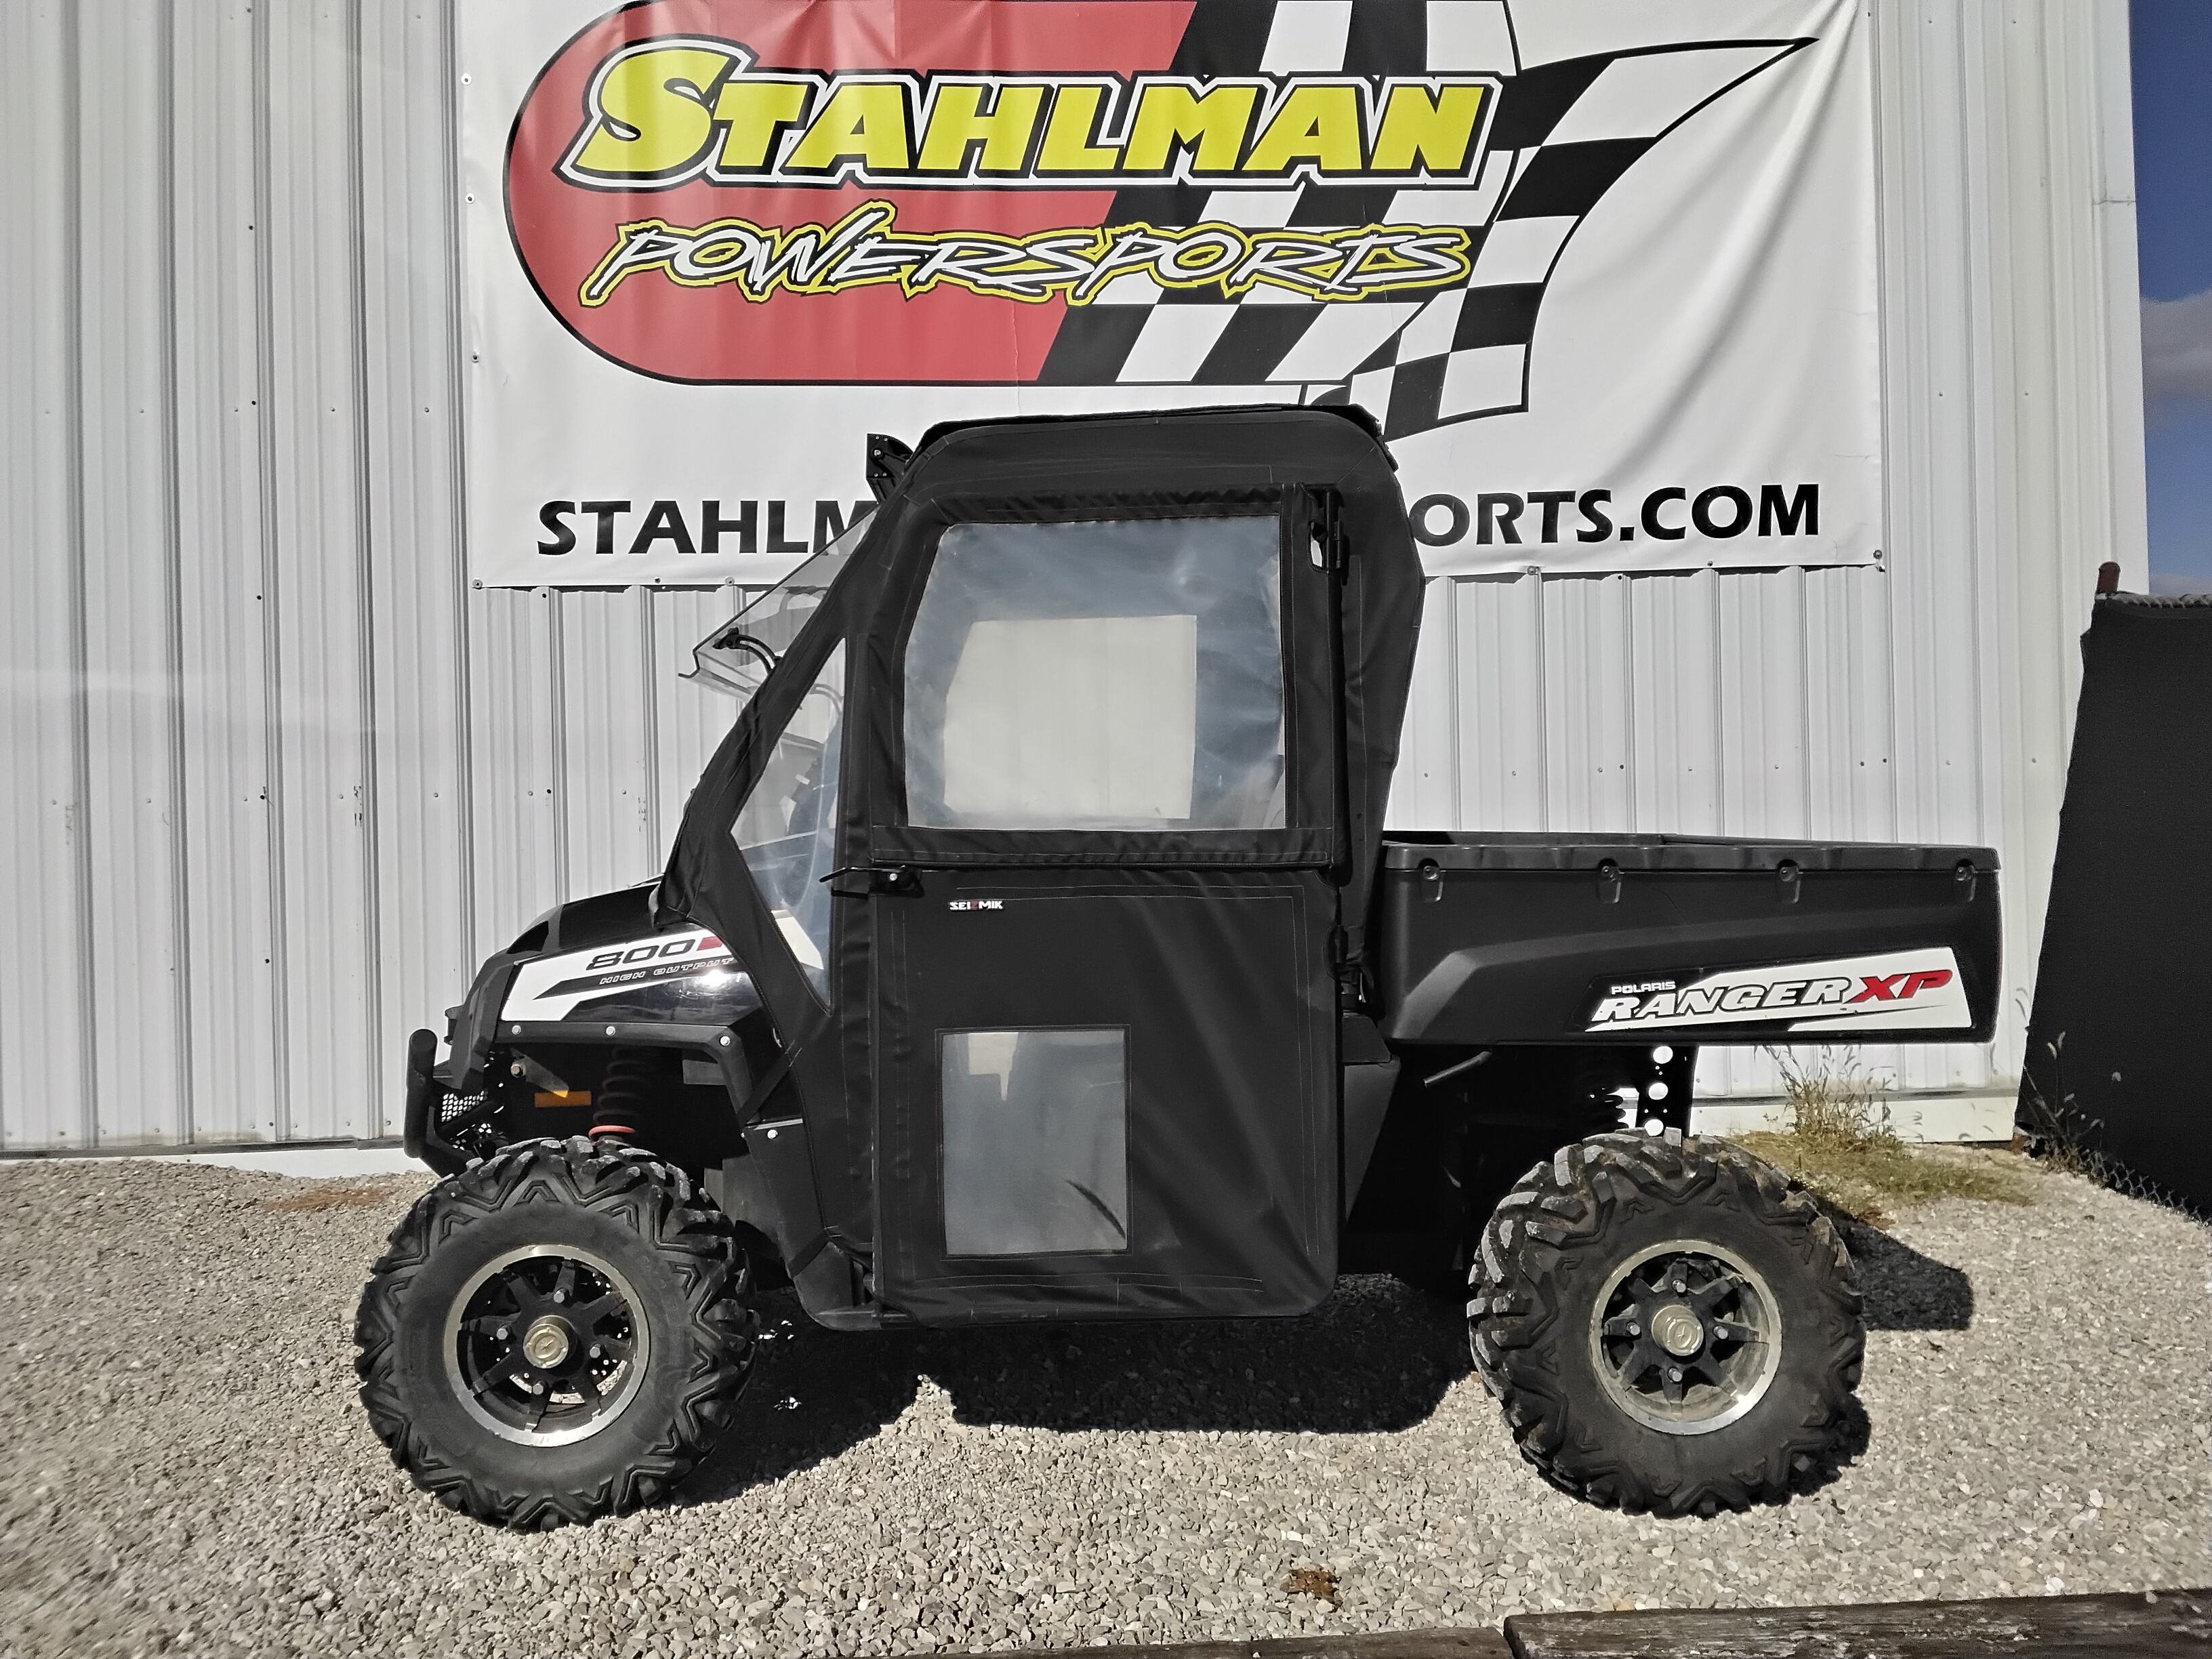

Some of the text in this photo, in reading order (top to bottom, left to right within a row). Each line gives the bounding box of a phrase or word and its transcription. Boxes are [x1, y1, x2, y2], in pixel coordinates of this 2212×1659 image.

[556, 37, 1502, 189] STAHLMAN
[580, 201, 1471, 306] POWERSPORTS
[949, 901, 1004, 910] SEIZMIK
[586, 939, 696, 971] 800
[599, 958, 735, 985] HIGH OUTPUT
[1591, 969, 1953, 1023] RANGER XP
[1611, 981, 1676, 995] POLARIS
